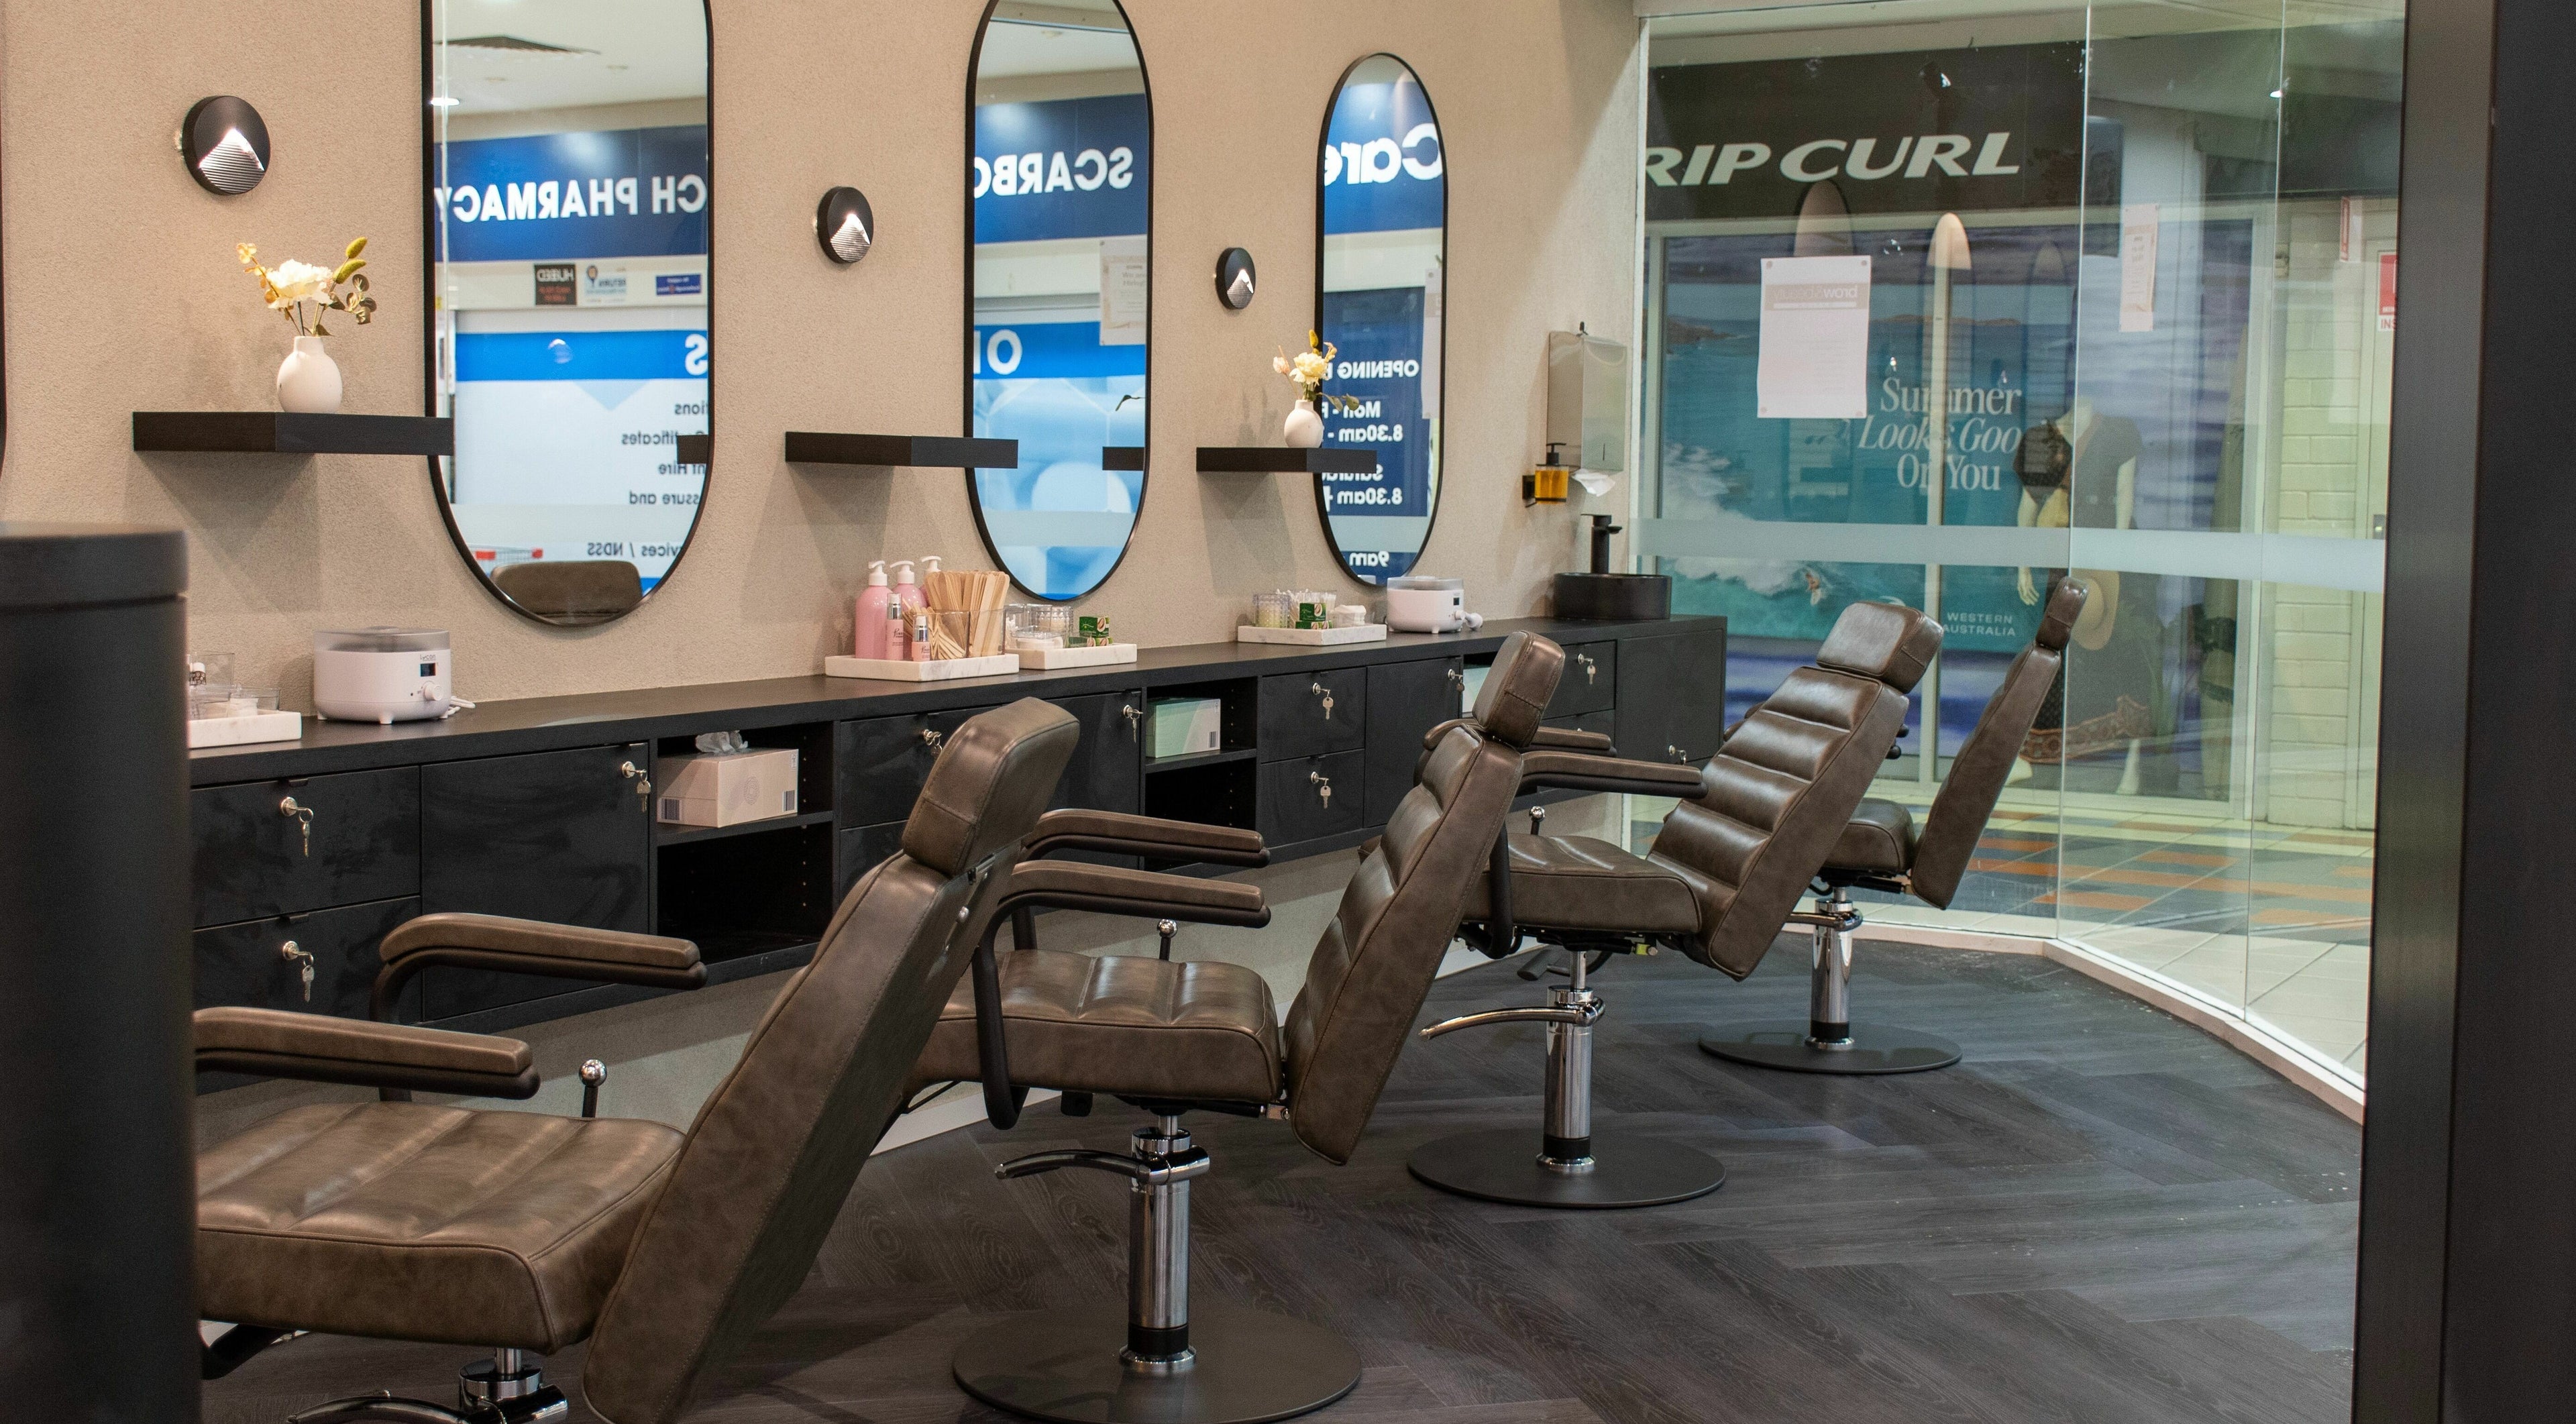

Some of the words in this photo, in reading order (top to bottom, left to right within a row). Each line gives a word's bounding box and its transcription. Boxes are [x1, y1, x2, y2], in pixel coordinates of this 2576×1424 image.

[1646, 142, 1771, 186] RIP
[1780, 132, 2019, 182] CURL
[1960, 417, 2022, 453] Goo
[1947, 455, 2001, 490] You
[1943, 624, 2015, 636] AUSTRALIA
[1947, 612, 2012, 624] WESTERN
